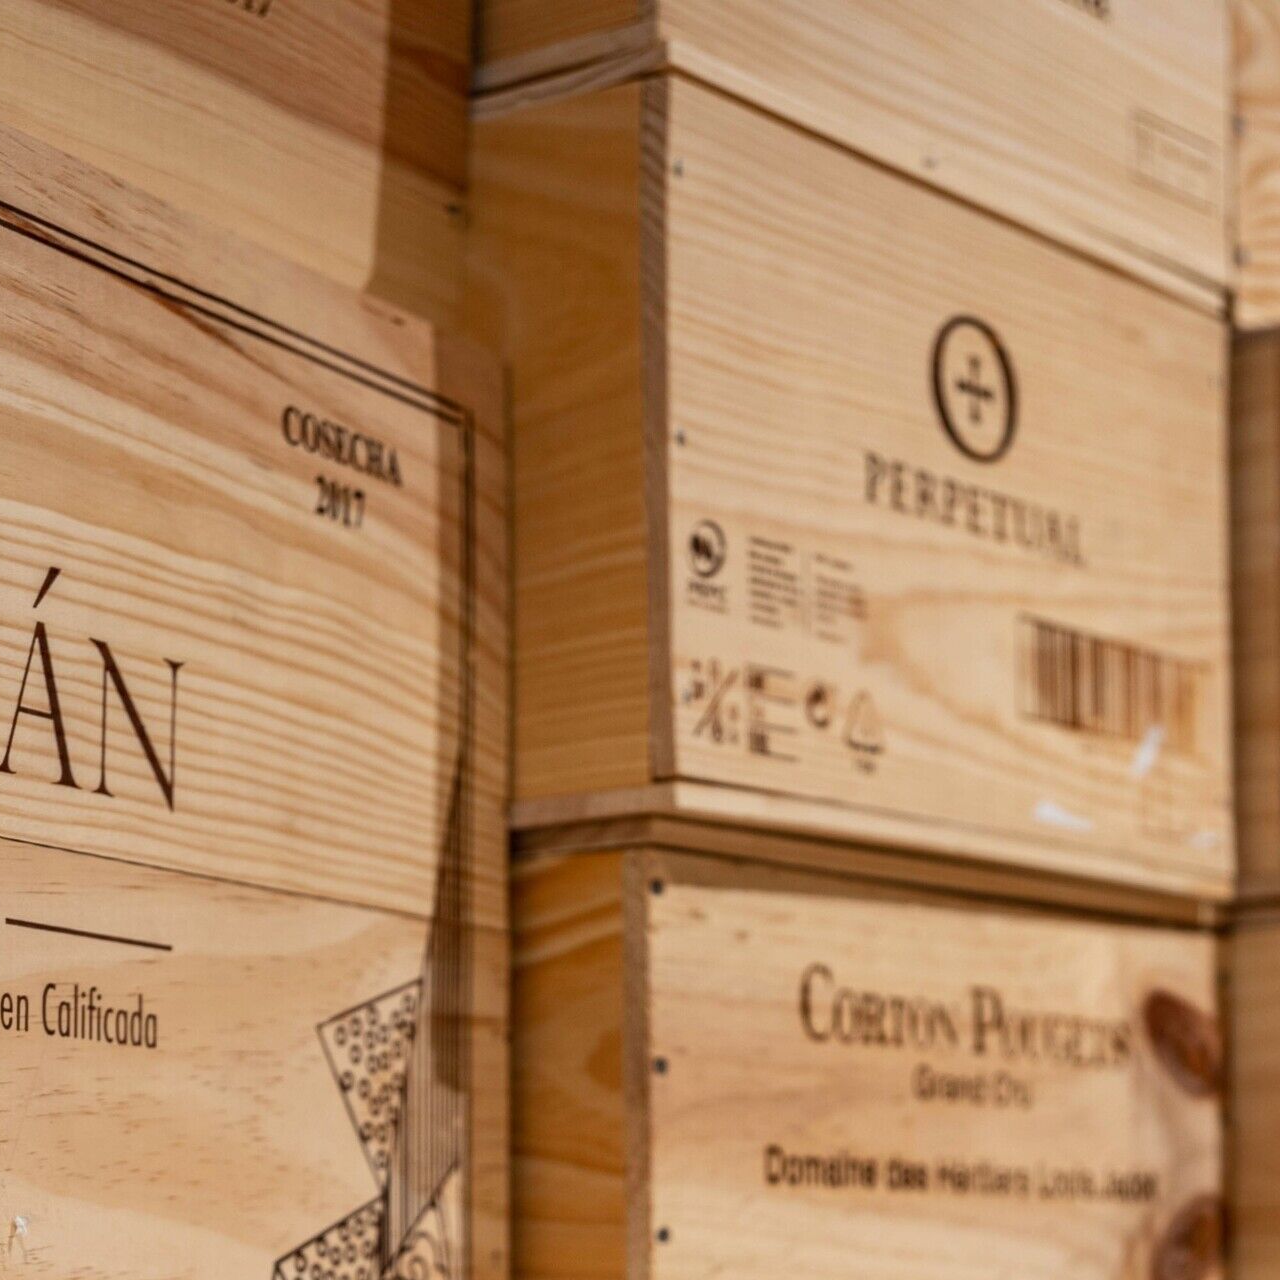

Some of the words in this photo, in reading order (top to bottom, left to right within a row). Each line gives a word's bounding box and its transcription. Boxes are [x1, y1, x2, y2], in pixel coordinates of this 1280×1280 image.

[282, 404, 404, 488] COSECHA
[315, 474, 366, 528] 2017
[864, 450, 1088, 568] PERPETUAL
[41, 982, 158, 1049] Calificada
